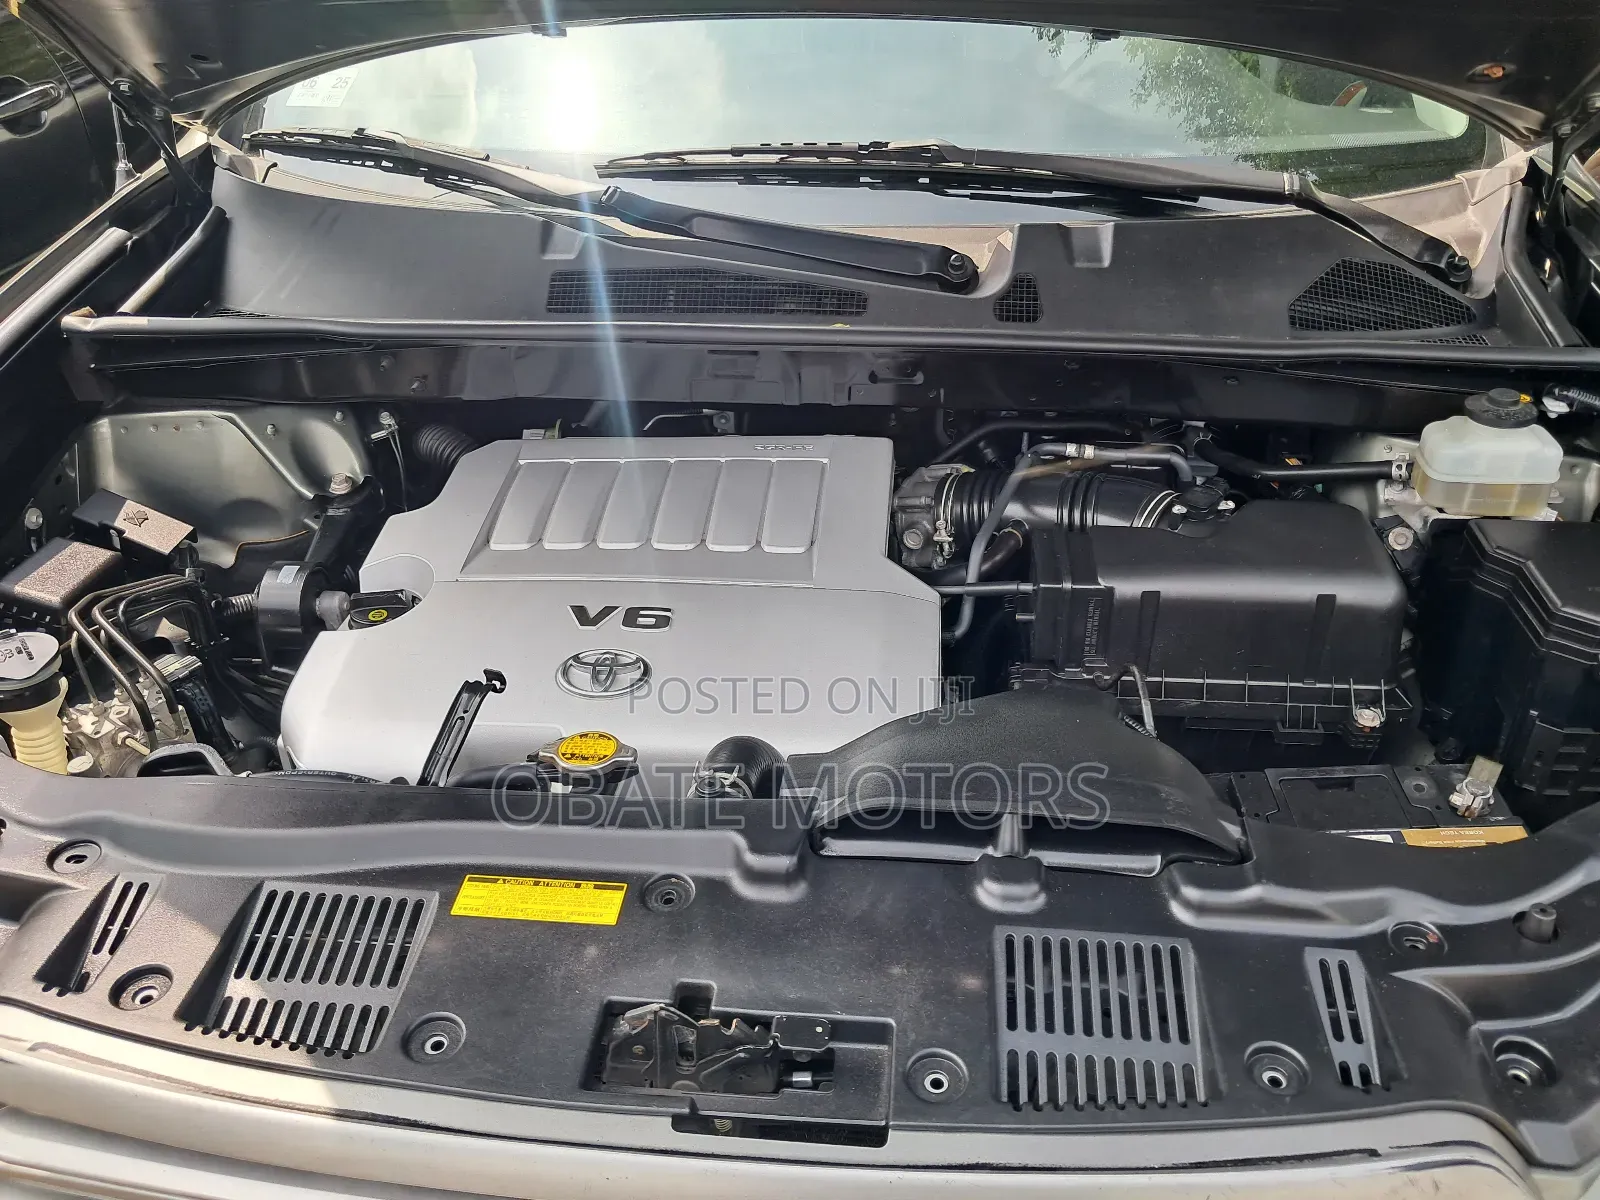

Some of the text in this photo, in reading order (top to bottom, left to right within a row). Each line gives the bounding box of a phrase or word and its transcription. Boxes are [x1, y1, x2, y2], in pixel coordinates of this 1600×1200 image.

[331, 76, 352, 89] 25
[567, 604, 675, 633] V6
[505, 878, 535, 886] CAUTION
[538, 880, 576, 889] ATTENTION
